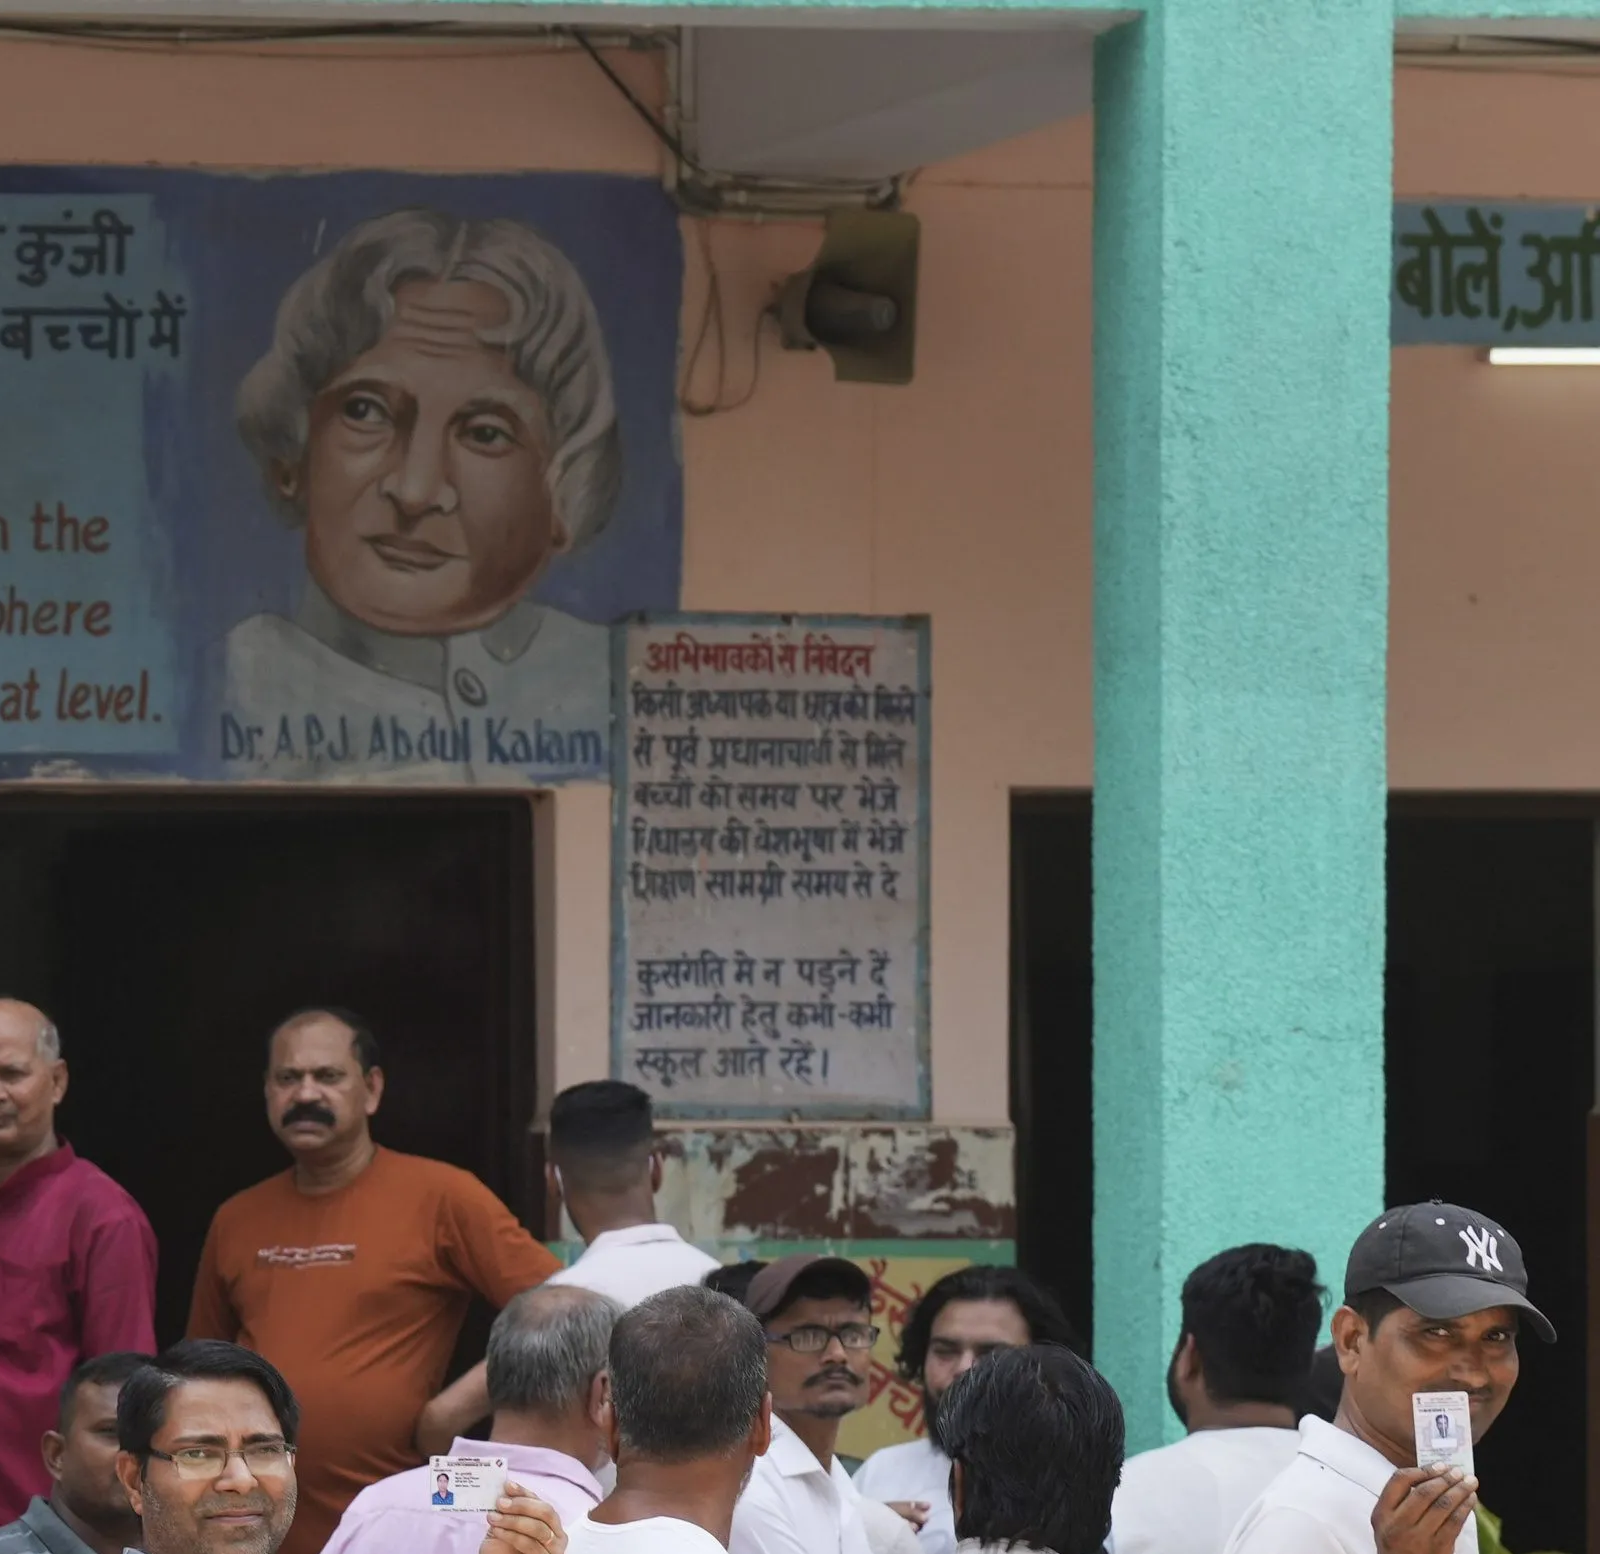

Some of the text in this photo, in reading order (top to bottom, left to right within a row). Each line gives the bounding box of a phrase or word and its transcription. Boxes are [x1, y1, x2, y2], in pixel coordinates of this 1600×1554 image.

[14, 208, 134, 288] कुंजी
[147, 290, 187, 359] में
[29, 500, 112, 555] the
[802, 633, 877, 677] निवेदन
[55, 668, 165, 724] level.
[367, 713, 473, 765] Abdul
[485, 715, 602, 766] Kalam
[806, 783, 847, 813] पर
[762, 958, 785, 988] न
